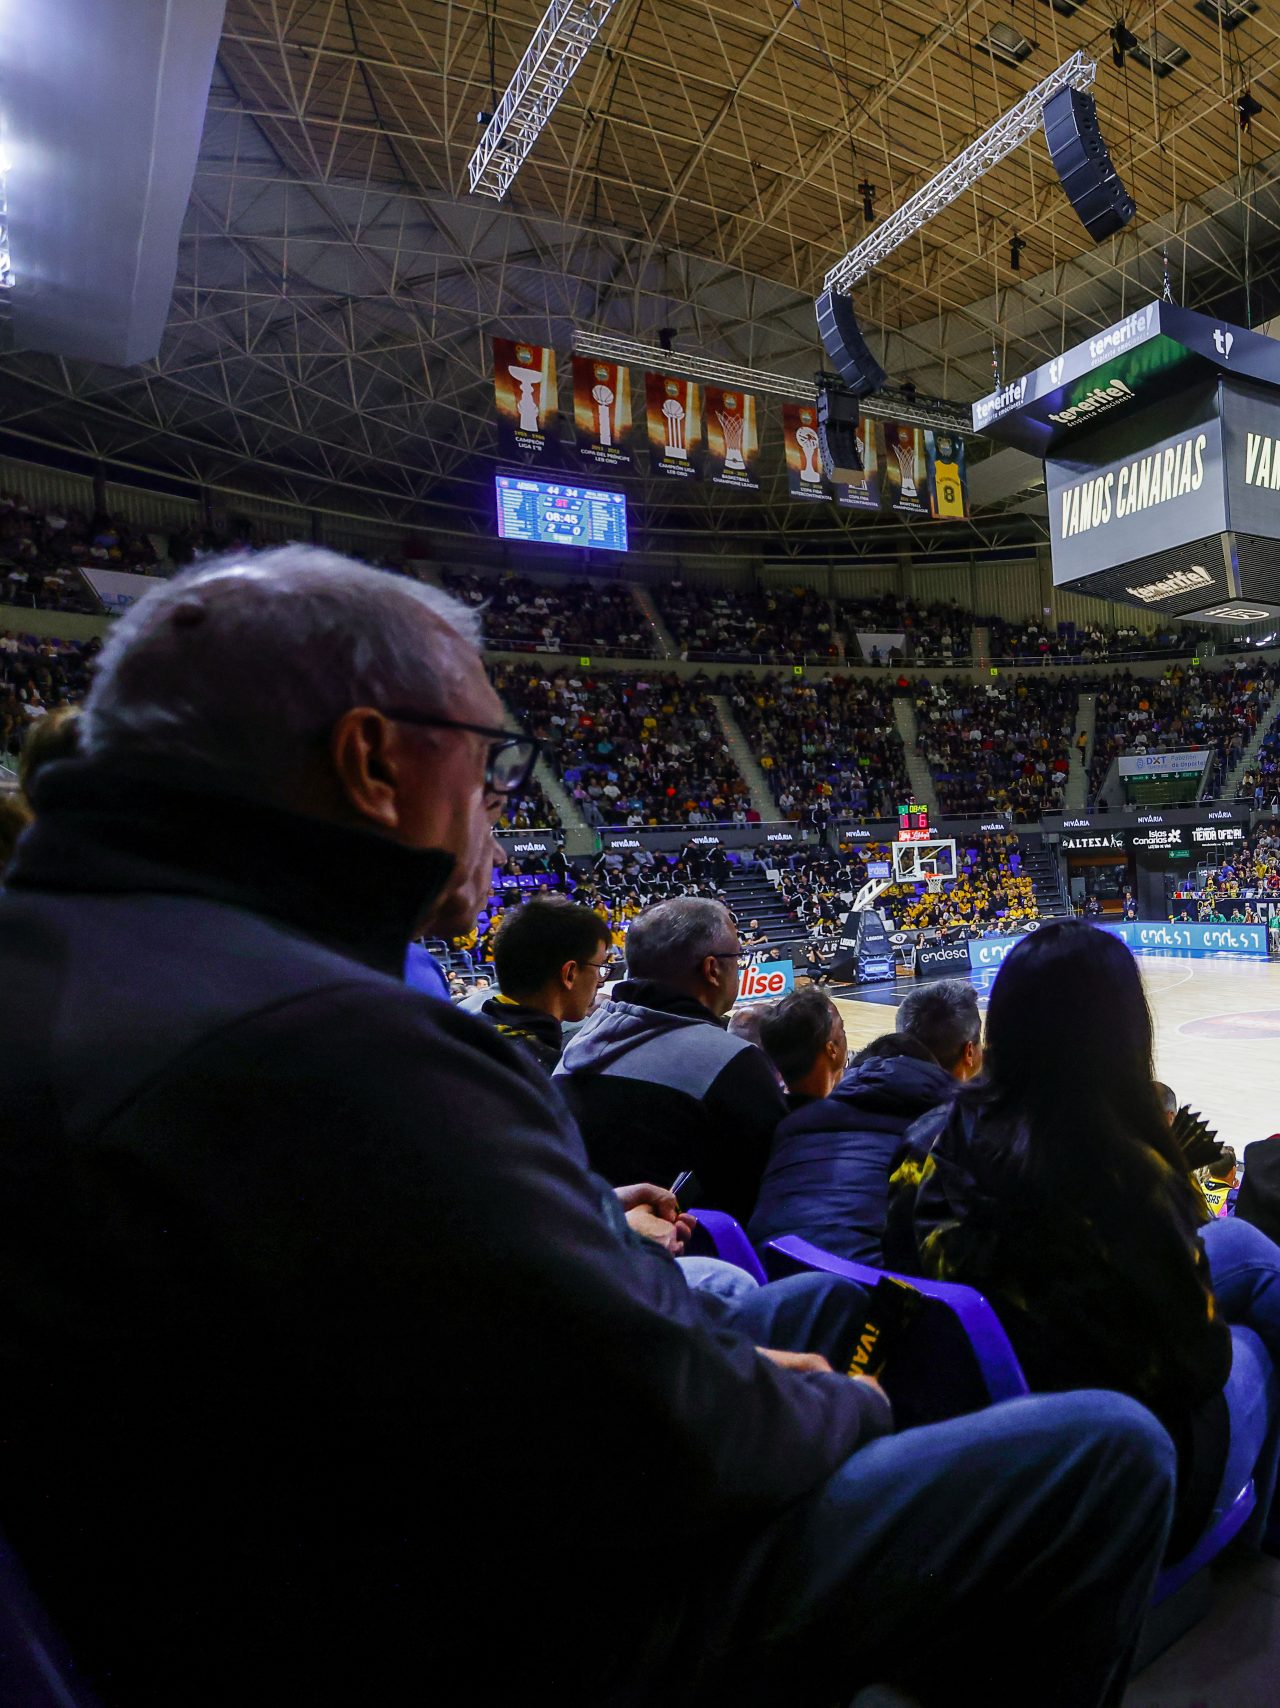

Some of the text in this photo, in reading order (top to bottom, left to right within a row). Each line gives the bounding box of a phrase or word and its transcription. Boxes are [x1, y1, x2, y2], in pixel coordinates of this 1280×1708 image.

[1089, 305, 1153, 358] tenerife!
[976, 376, 1027, 420] tenerife!
[1048, 379, 1135, 424] tenerife!
[547, 486, 559, 495] 44
[566, 489, 578, 497] 34
[1062, 435, 1206, 539] VAMOS CANARIAS
[943, 485, 955, 503] 8
[1147, 756, 1167, 765] DXT
[1137, 815, 1163, 823] NIVARIA
[1208, 810, 1232, 819] NIVARIA
[919, 814, 927, 827] 6
[1063, 818, 1090, 827] NIVARIA
[981, 823, 1005, 831] NIVARIA
[767, 832, 793, 841] NIVARIA
[846, 829, 870, 838] NIVARIA
[1149, 830, 1167, 838] Islas
[514, 842, 547, 852] NIVARIA
[611, 839, 640, 848] NIVARIA
[921, 948, 968, 963] endesa
